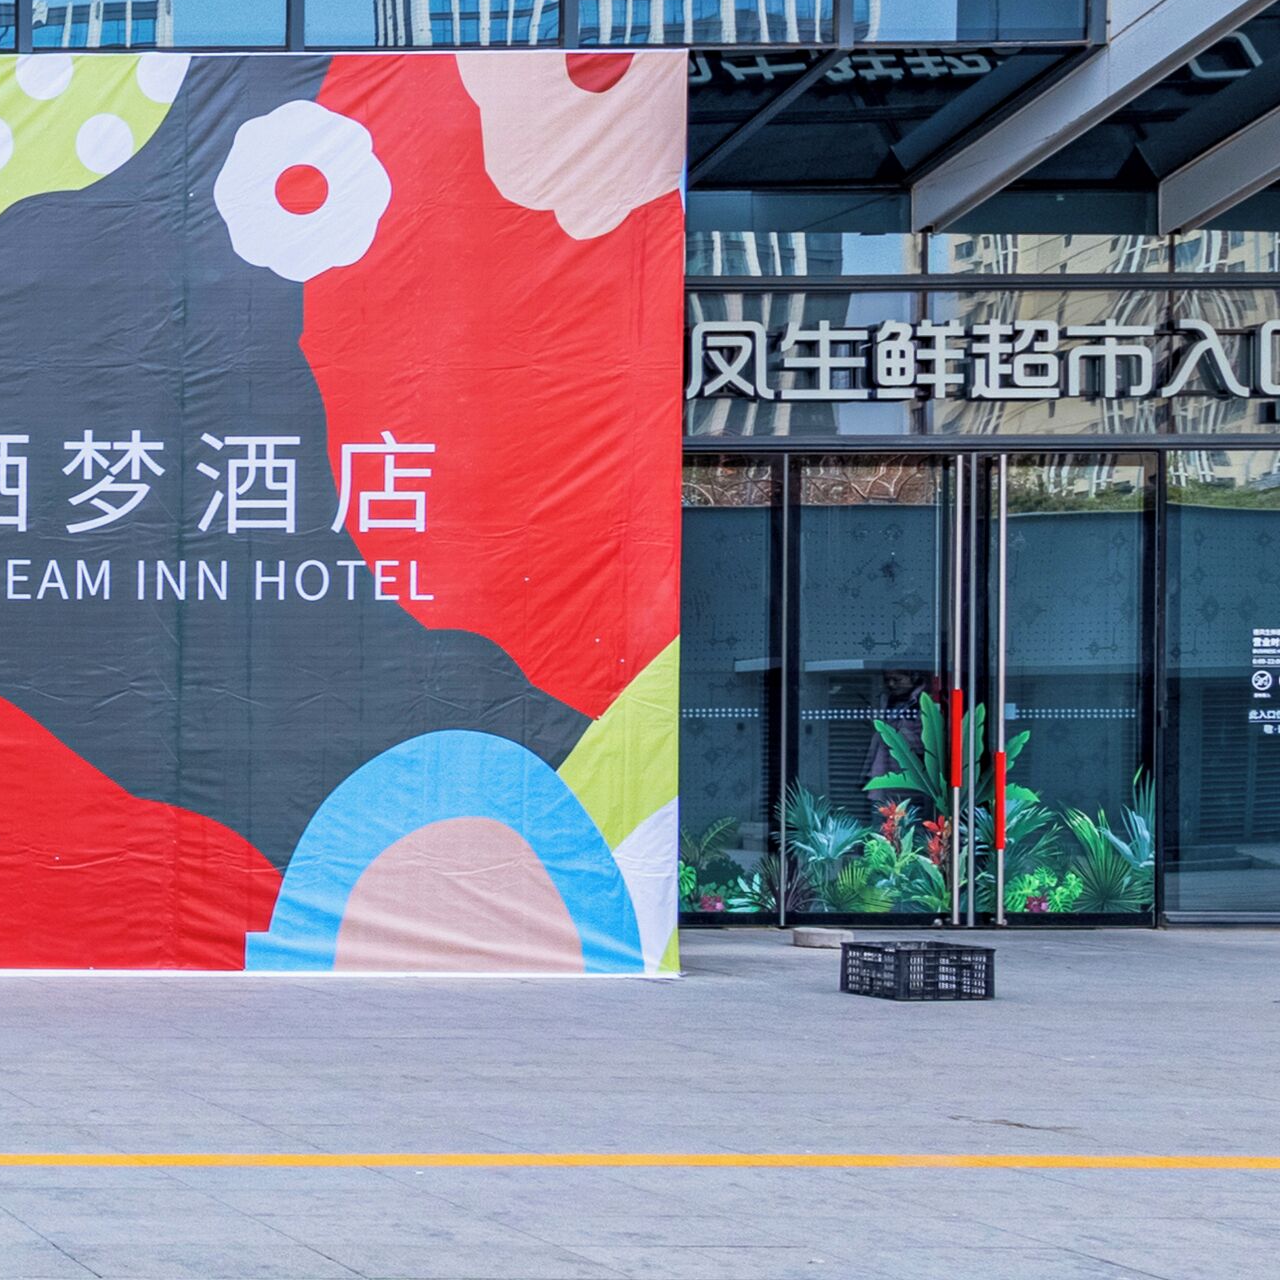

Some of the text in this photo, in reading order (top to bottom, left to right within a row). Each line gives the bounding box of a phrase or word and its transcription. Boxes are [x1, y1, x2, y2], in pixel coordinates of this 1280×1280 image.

[686, 319, 1280, 400] 凤生鲜超市入
[137, 559, 228, 601] INN
[254, 559, 434, 601] HOTEL
